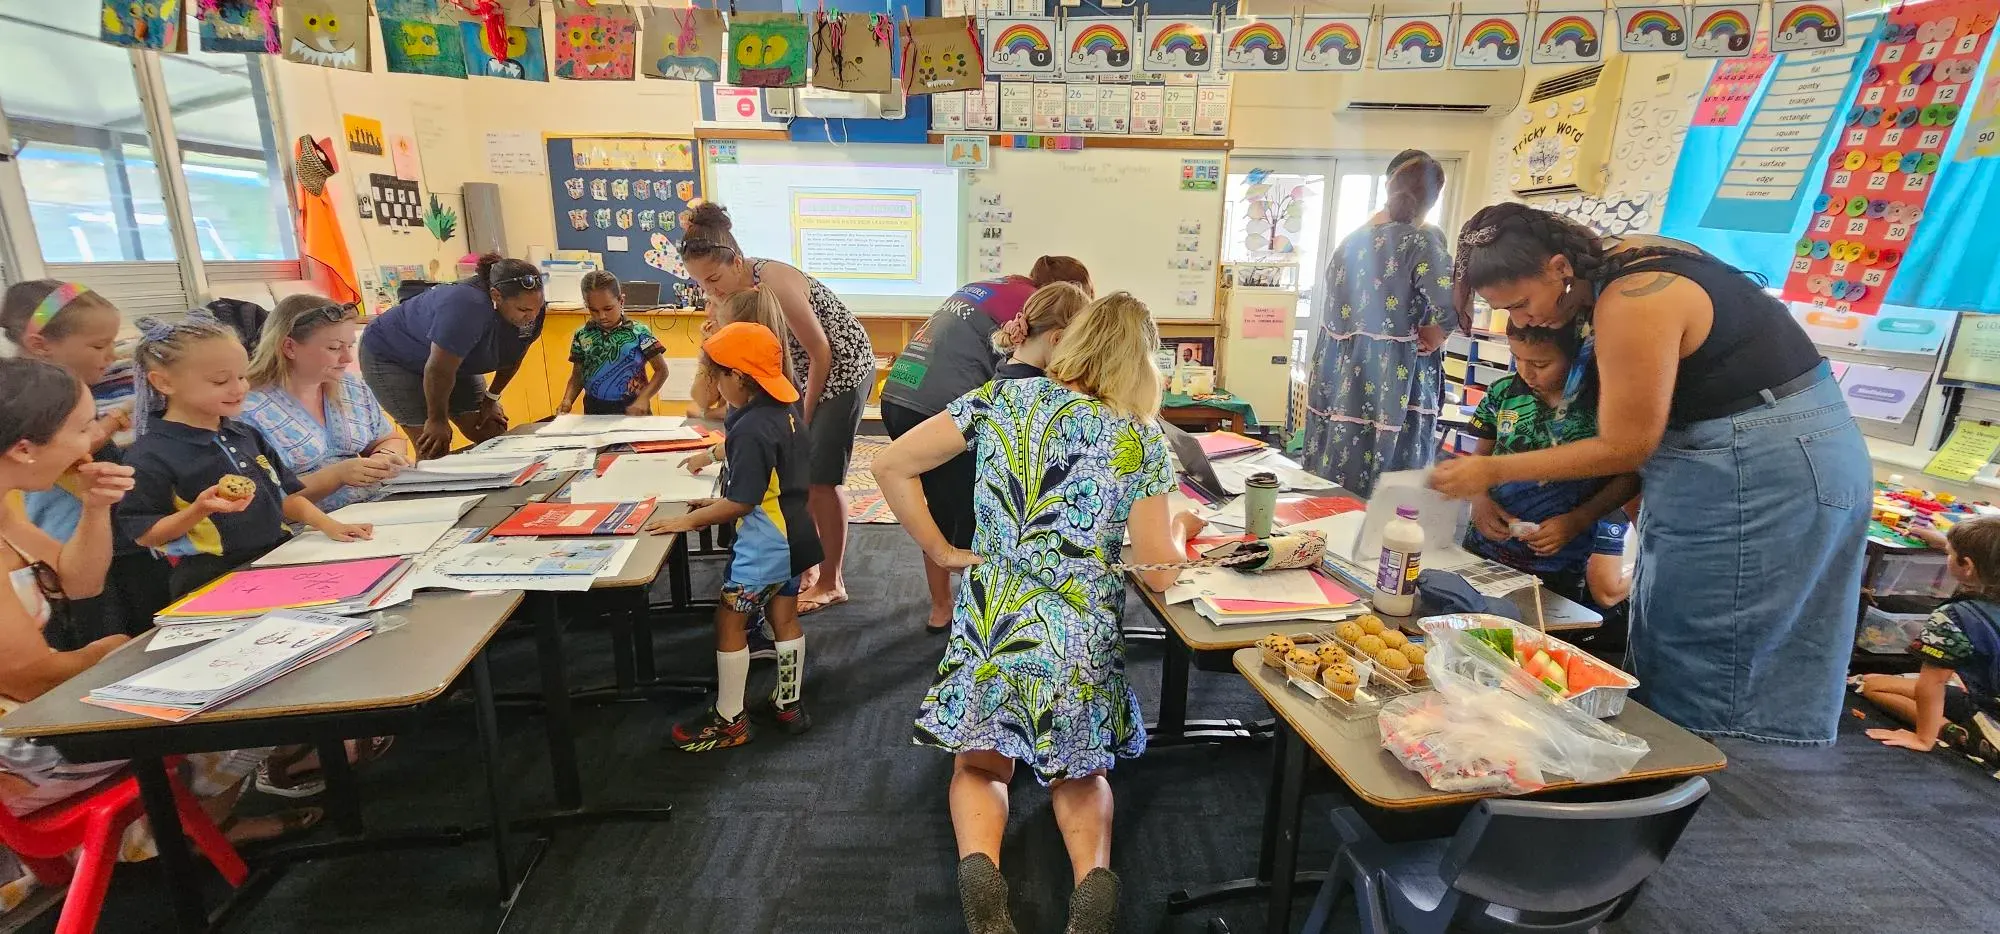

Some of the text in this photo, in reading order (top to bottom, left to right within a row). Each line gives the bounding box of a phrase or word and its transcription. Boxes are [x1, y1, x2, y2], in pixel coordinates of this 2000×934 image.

[1633, 32, 1677, 42] 2 8
[1786, 28, 1836, 41] 0 10
[1736, 38, 1743, 47] 9
[1963, 40, 1971, 49] 6
[1468, 46, 1511, 56] 4 6
[1545, 43, 1591, 54] 3 7
[998, 53, 1044, 62] 10 0
[1078, 53, 1121, 62] 9 1
[1156, 52, 1200, 61] 8 2
[1235, 51, 1279, 60] 7 3
[1310, 51, 1353, 60] 6 4
[1392, 50, 1435, 59] 5 5
[1889, 50, 1898, 60] 2
[1004, 88, 1015, 97] 24
[1037, 89, 1048, 98] 25
[1070, 90, 1082, 99] 26
[1102, 90, 1113, 99] 27
[1134, 91, 1146, 100] 28
[1167, 92, 1179, 101] 29
[1201, 91, 1214, 100] 30
[1870, 92, 1878, 100] 8
[1902, 88, 1914, 97] 10
[1939, 90, 1954, 100] 12
[1789, 96, 1815, 105] triangle
[1779, 113, 1812, 121] rectangle
[1512, 122, 1584, 155] Tricky Word
[1852, 133, 1862, 141] 14
[1887, 133, 1898, 141] 16
[1924, 134, 1938, 144] 18
[1978, 132, 1995, 143] 90
[1836, 175, 1847, 184] 20
[1872, 176, 1885, 186] 22
[1908, 178, 1923, 186] 24
[1820, 220, 1830, 228] 26
[1851, 223, 1864, 232] 28
[1890, 228, 1905, 237] 30
[1796, 261, 1807, 269] 32
[1835, 263, 1845, 272] 34
[1866, 273, 1880, 282] 36
